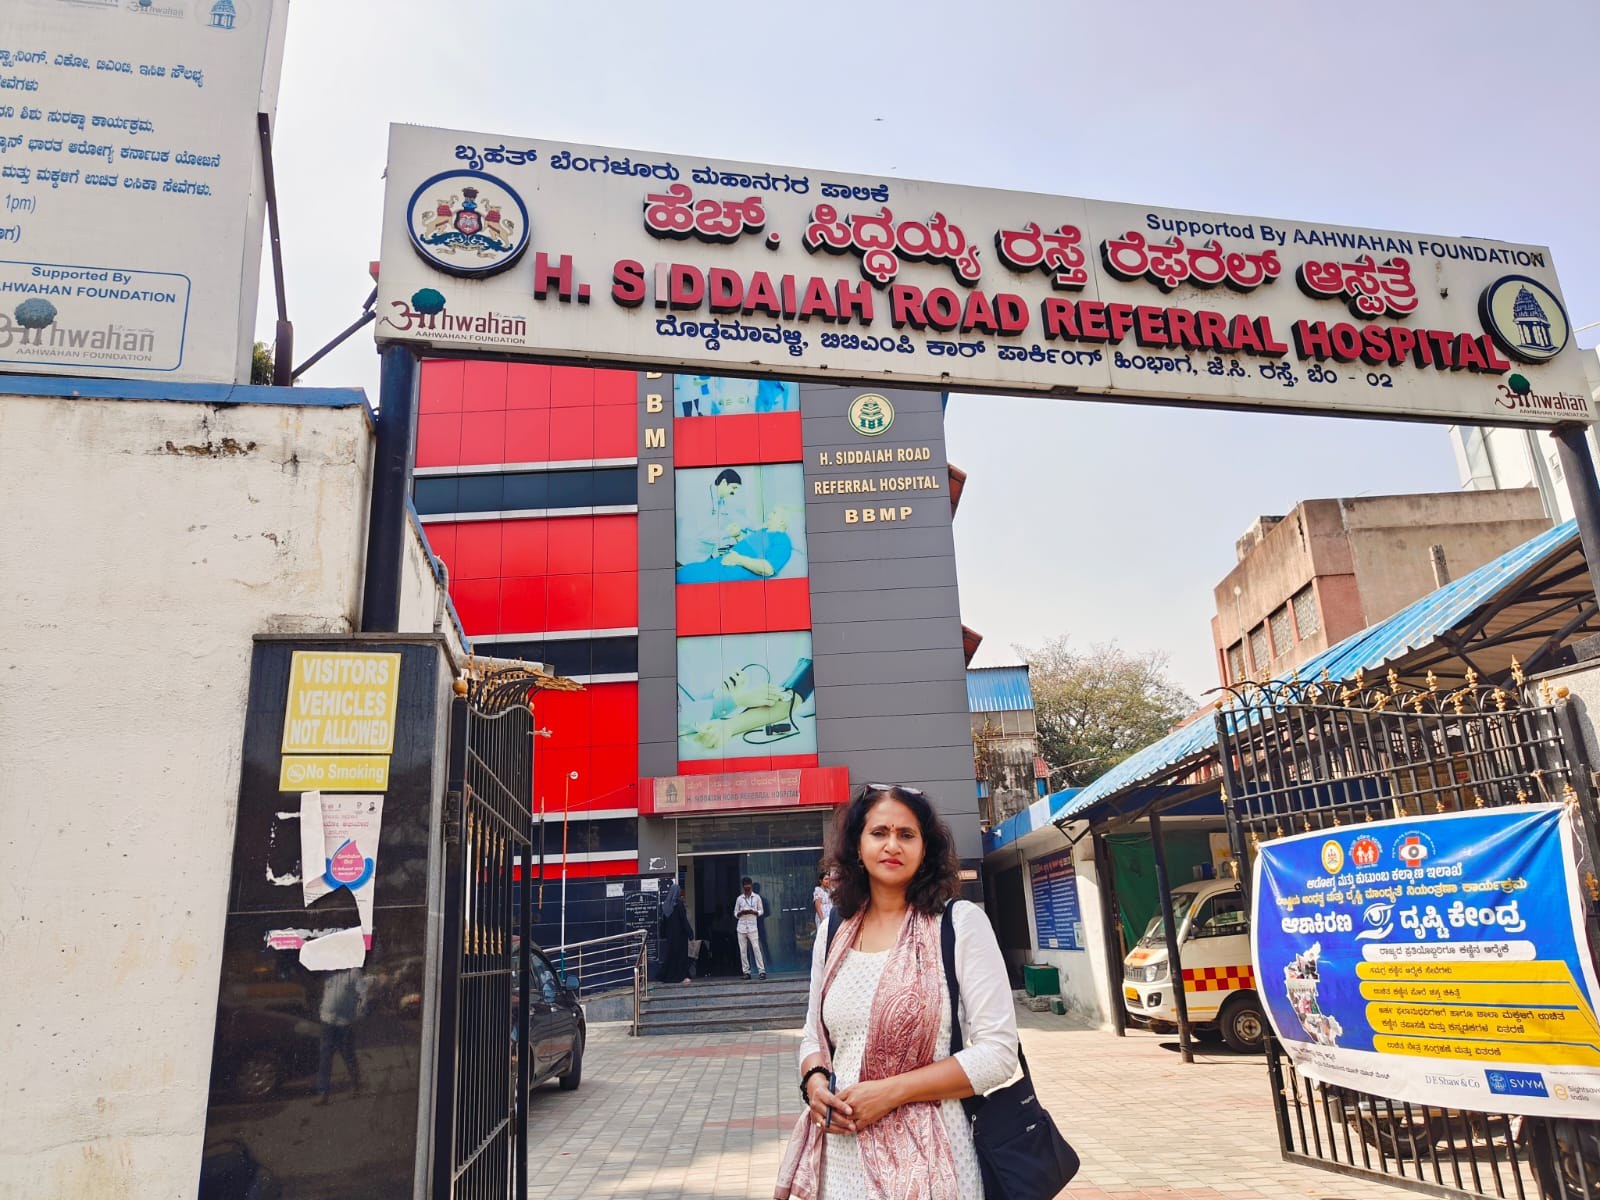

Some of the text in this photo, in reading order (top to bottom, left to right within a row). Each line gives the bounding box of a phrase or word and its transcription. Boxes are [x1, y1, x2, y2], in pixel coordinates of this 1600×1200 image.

[171, 65, 205, 88] ಸೌಲಭ್ಯ
[28, 138, 63, 152] ಭಾರತ
[68, 140, 114, 164] ಆರೋಗ್ಯ
[120, 145, 170, 162] ಕರ್ನಾಟಕ
[175, 151, 221, 167] ಯೋಜನೆ
[2, 164, 31, 184] ಮತ್ತು
[36, 168, 80, 189] ಮಕ್ಕಳಿಗೆ
[85, 173, 119, 187] ಉಚಿತ
[123, 177, 157, 191] ಲಸಿಕಾ
[455, 144, 890, 203] ಬೃಹತ್ ಬೆಂಗಳೂರು ಮಹಾನಗರ ಪಾಲಿಕೆ
[6, 194, 36, 214] 1pm)
[1259, 225, 1287, 246] By
[1293, 229, 1414, 255] AAHWAHAN
[1418, 240, 1546, 268] FOUNDATION
[31, 266, 132, 285] Supported By
[994, 222, 1089, 292] ರಸ್ತೆ
[1101, 230, 1282, 295] ರೆಫರಲ್
[1295, 253, 1419, 321] ಆಸ್ಪತ್ರೆ
[0, 281, 176, 303] HWAHAN FOUNDATION
[533, 251, 1511, 375] H. SIDDAIAH ROAD REFERRAL HOSPITAL
[415, 331, 526, 344] AAHWAHAN FOUNDATION
[16, 347, 152, 361] AAHWAHAN FOUNDATION
[820, 331, 915, 354] ಬಿಬಿಎಂಪಿ
[926, 339, 986, 358] ಕಾರ್
[997, 344, 1103, 367] ಪಾರ್ಕಿಂಗ್
[1114, 351, 1198, 376] ಹಿಂಭಾಗ,
[1258, 360, 1299, 387] ರಸ್ತೆ,
[1306, 364, 1338, 384] ಬೆಂ
[819, 447, 931, 466] H. SIDDAIAH ROAD
[814, 475, 940, 496] REFERRAL HOSPITAL
[302, 658, 389, 685] VISITORS
[298, 690, 387, 717] VEHICLES
[290, 720, 389, 746] NOT ALLOWED
[306, 763, 384, 783] No Smoking
[1338, 872, 1356, 889] ಮತ್ತು
[1356, 871, 1390, 884] ಕುಟುಂಬ
[1391, 867, 1424, 885] ಕಲ್ಯಾಣ
[1426, 862, 1463, 879] ಇಲಾಖೆ
[1281, 899, 1526, 939] ಆಶಾಕಿರಣ ದೃಷ್ಟಿ ಕೇಂದ್ರ
[1509, 1078, 1545, 1090] SVYM
